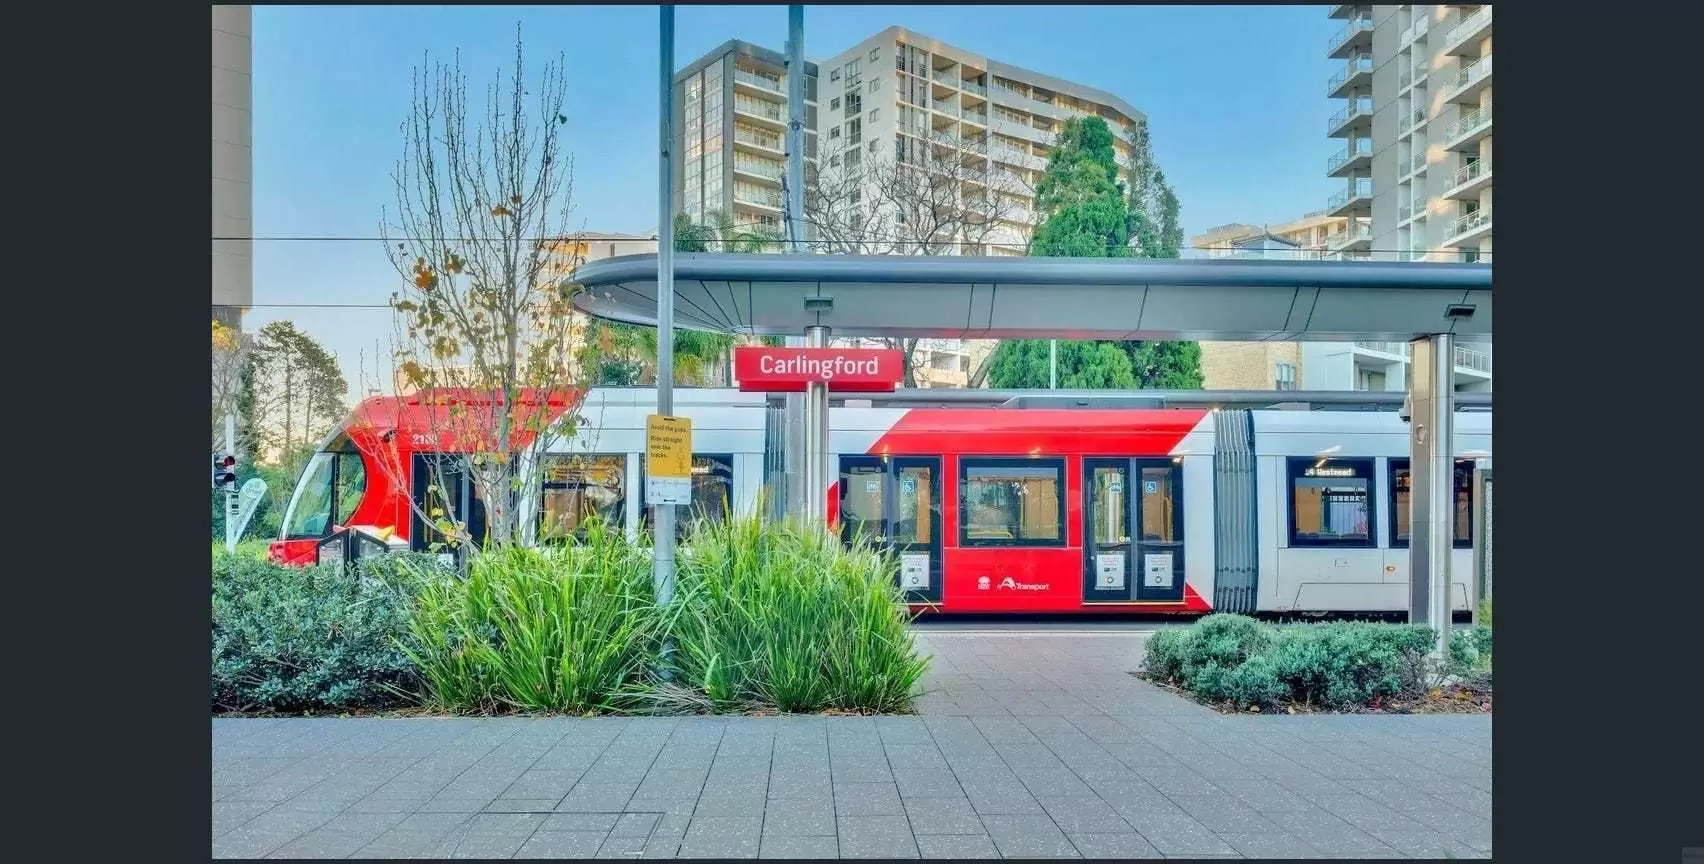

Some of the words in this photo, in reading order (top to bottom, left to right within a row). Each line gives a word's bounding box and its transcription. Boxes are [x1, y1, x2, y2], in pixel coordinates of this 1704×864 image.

[760, 355, 879, 379] Carlingford
[663, 436, 683, 444] straight
[1016, 582, 1049, 591] Transport
